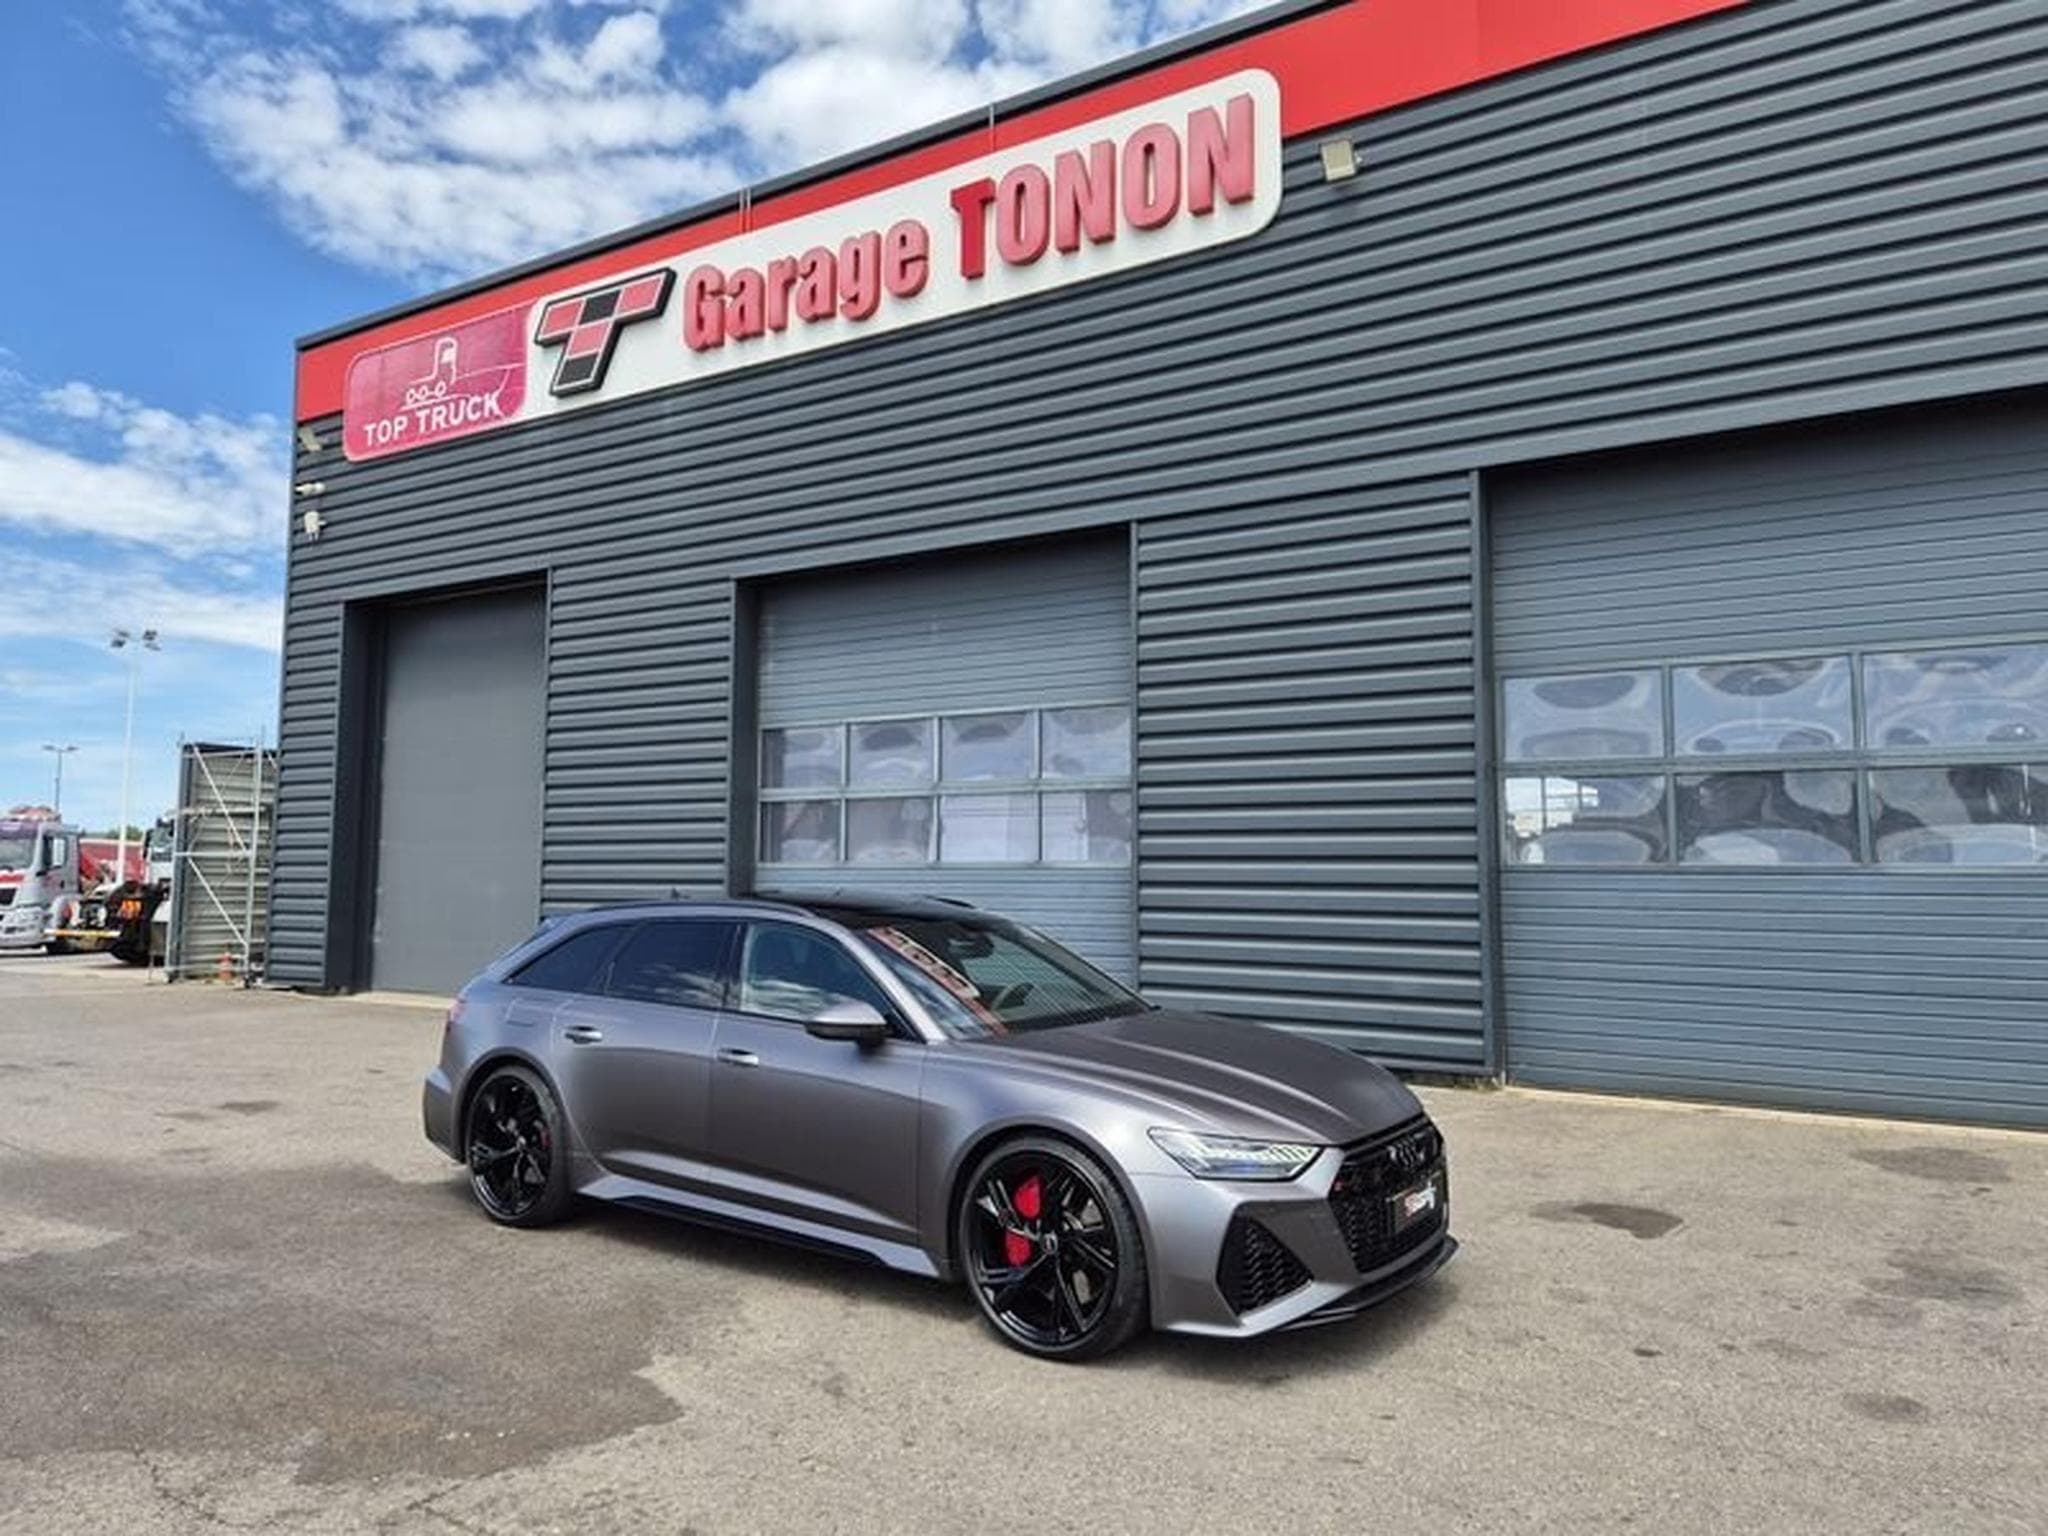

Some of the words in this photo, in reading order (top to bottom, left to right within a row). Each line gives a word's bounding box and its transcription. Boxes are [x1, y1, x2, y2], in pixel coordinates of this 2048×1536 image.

[684, 220, 929, 351] Garage
[950, 93, 1255, 279] TONON
[364, 416, 408, 446] TOP
[415, 393, 503, 433] TRUCK
